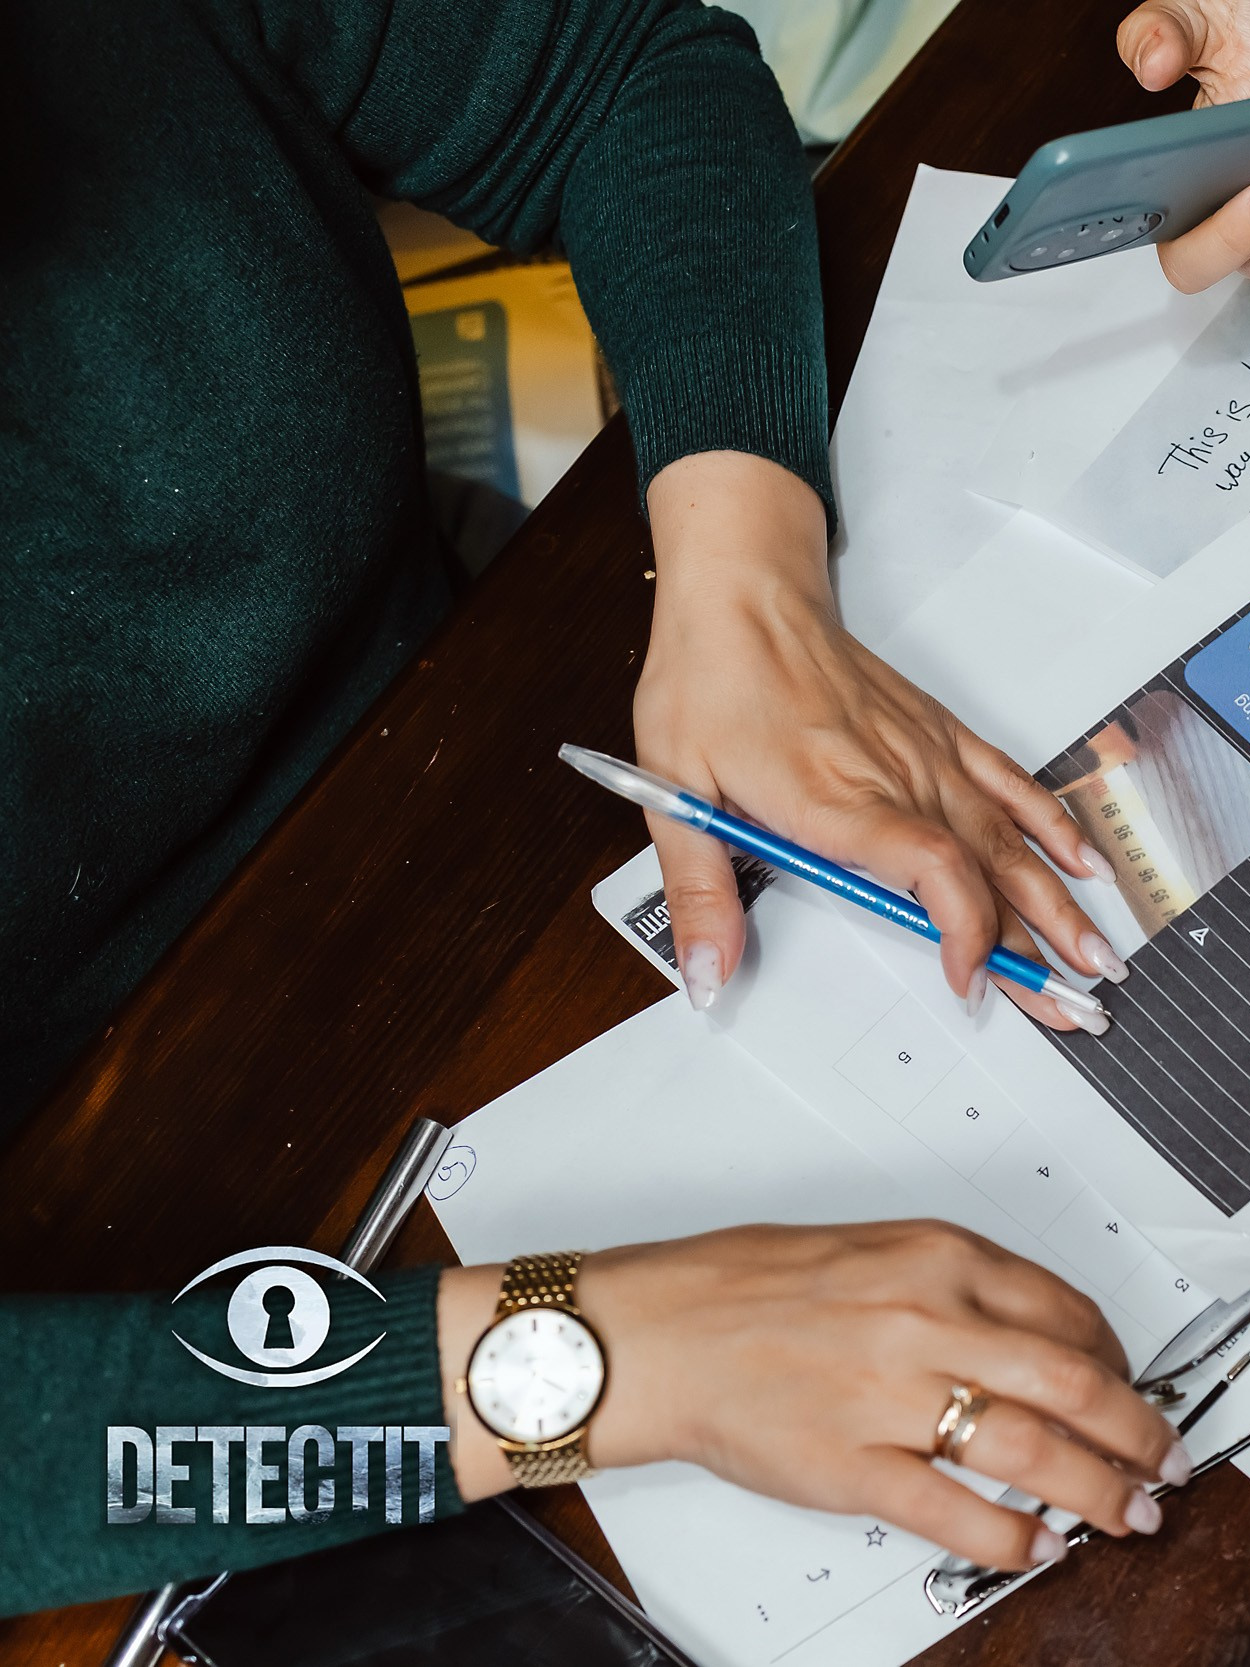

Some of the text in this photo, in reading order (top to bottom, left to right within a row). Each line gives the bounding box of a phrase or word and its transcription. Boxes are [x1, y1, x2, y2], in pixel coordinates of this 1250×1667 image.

[1157, 426, 1228, 474] This
[1098, 798, 1123, 822] 99
[1111, 820, 1135, 844] 98
[1123, 842, 1148, 865] 97
[1136, 863, 1160, 886] 96
[1147, 884, 1172, 907] 95
[898, 1051, 912, 1064] 5
[965, 1107, 980, 1120] 5
[1037, 1166, 1050, 1178] 4
[1105, 1222, 1119, 1234] 4
[1175, 1278, 1190, 1293] 3
